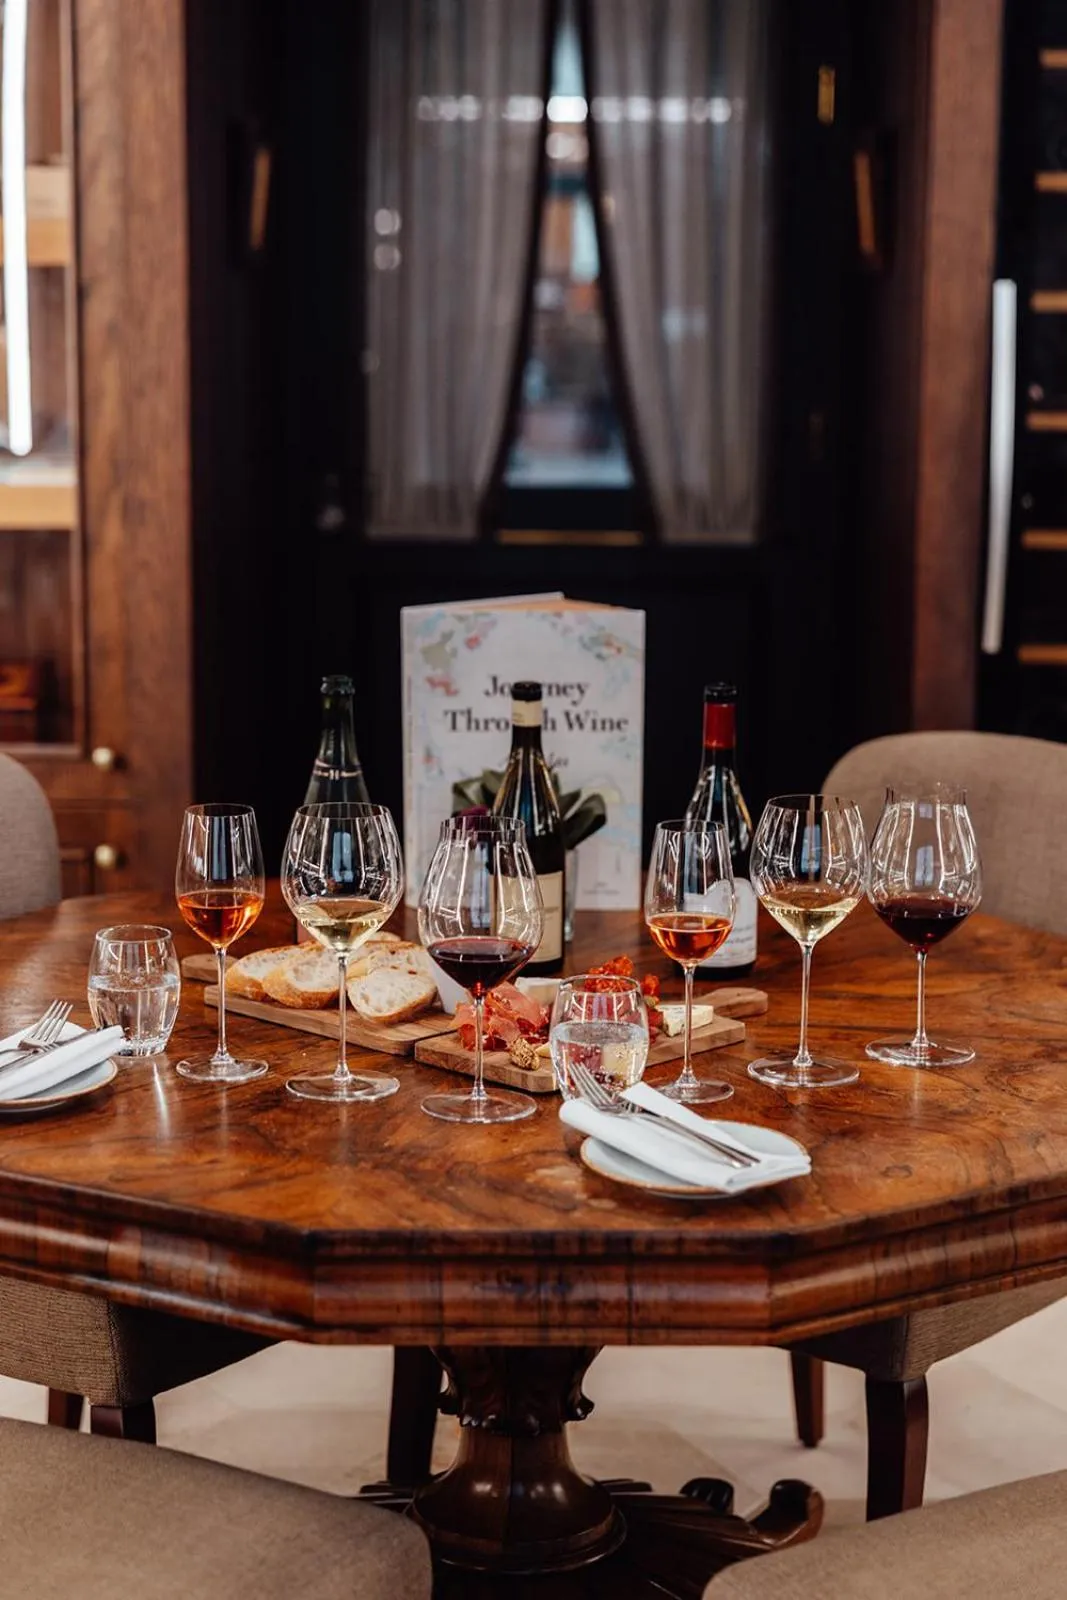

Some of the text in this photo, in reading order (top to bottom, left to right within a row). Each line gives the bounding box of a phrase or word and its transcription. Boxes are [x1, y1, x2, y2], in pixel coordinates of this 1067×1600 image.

[484, 675, 590, 706] Joney
[444, 707, 557, 733] Throh
[563, 708, 629, 733] Wine
